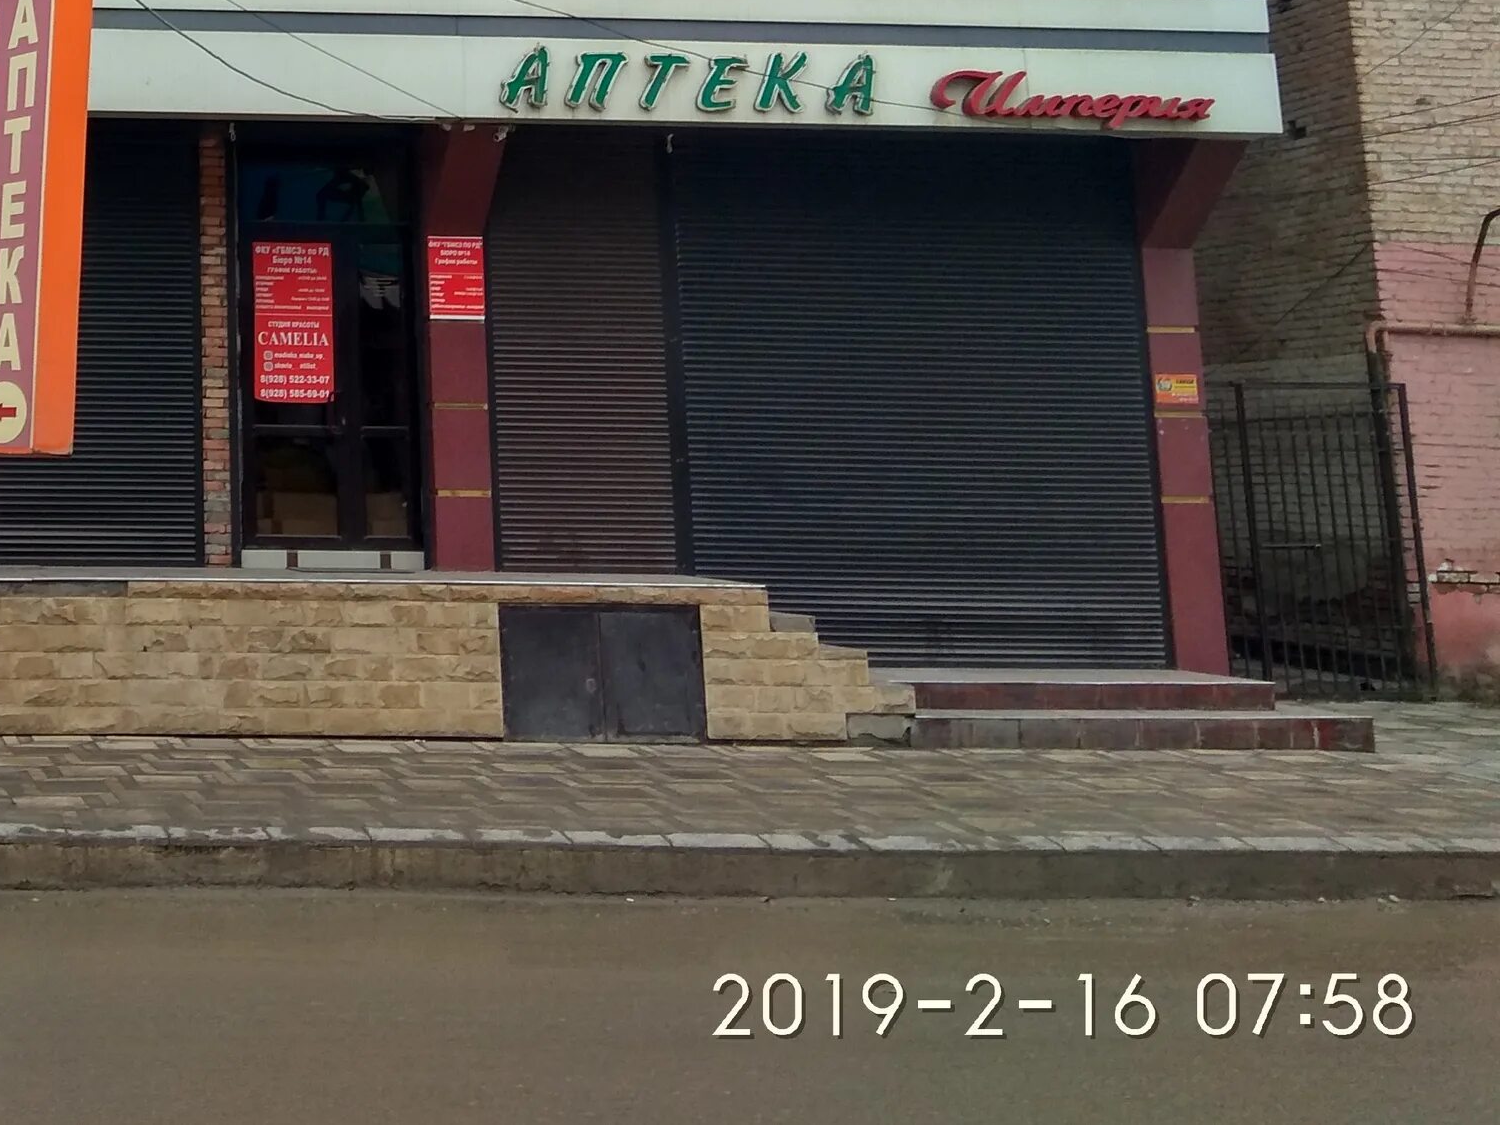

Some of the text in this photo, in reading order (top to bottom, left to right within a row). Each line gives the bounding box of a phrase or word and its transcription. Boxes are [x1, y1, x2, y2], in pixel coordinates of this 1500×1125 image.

[499, 44, 1216, 129] АПТЕКА Империя
[257, 331, 329, 347] CAMELIA
